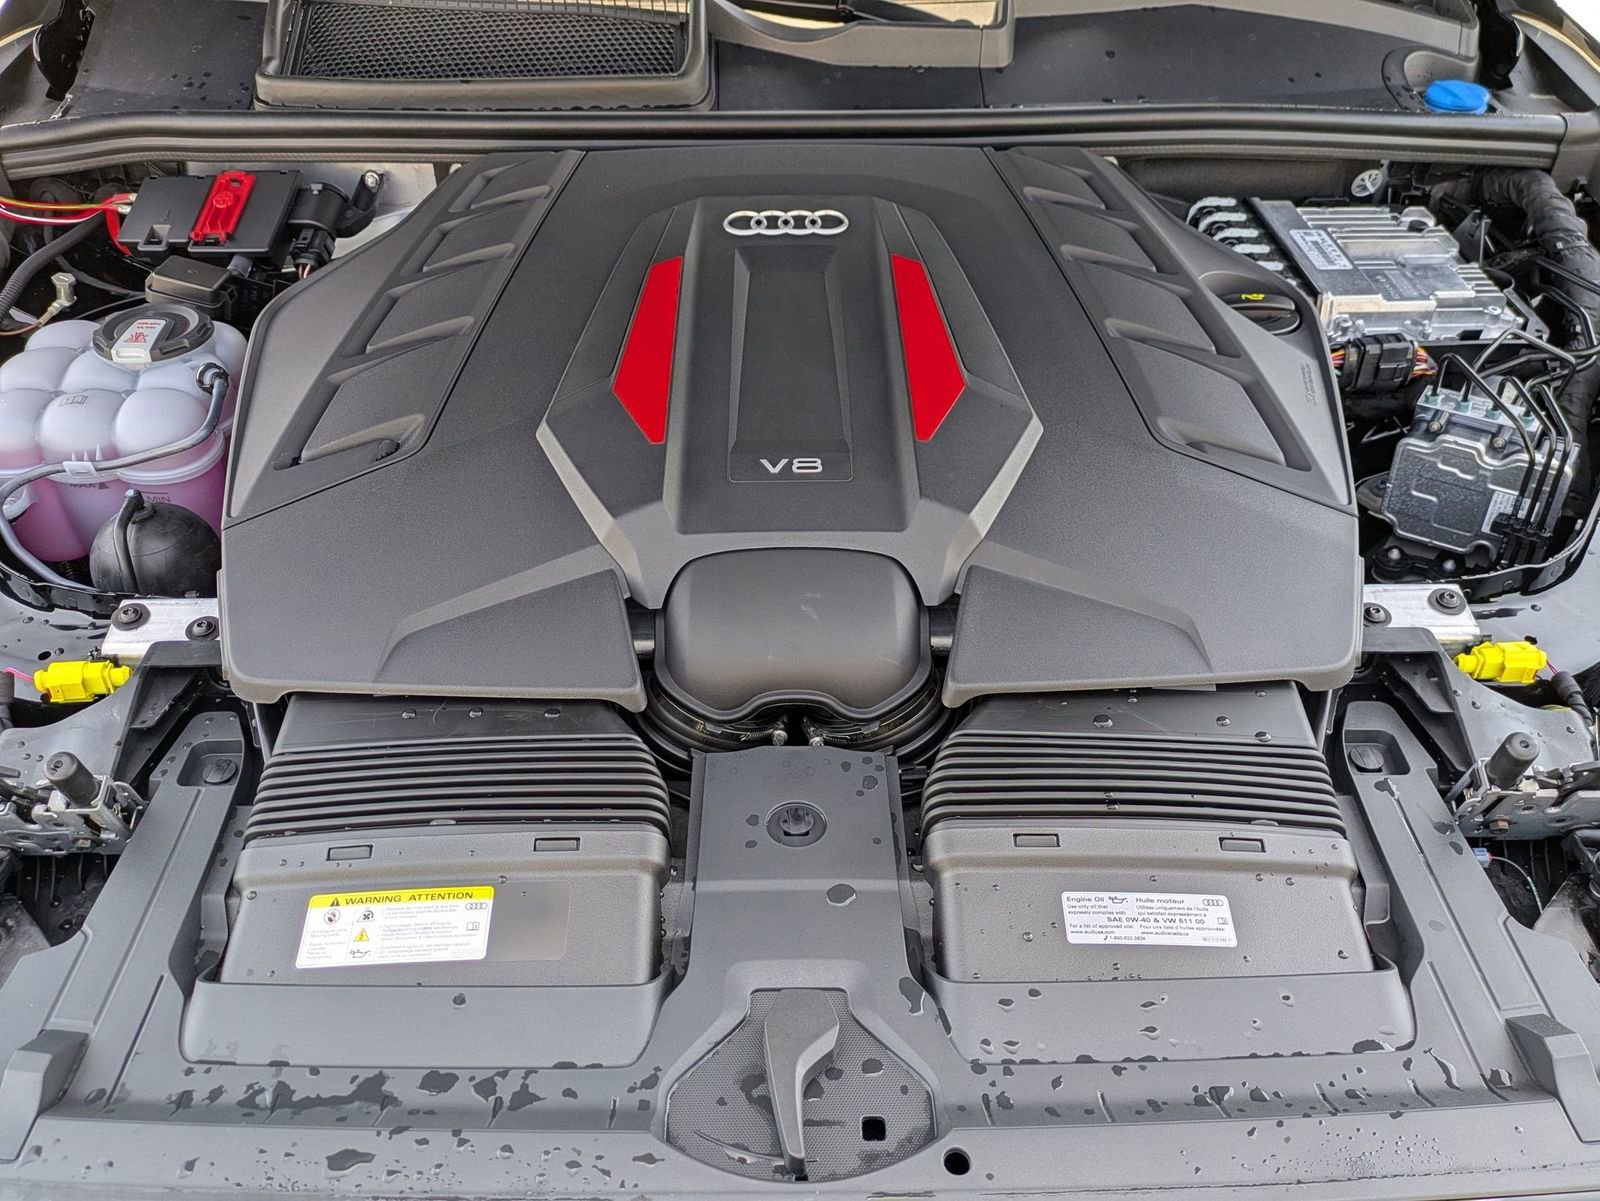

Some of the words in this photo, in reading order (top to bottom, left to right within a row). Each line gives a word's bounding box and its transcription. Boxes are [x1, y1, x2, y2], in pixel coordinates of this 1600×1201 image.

[760, 458, 822, 473] V8
[345, 895, 402, 905] WARNING
[408, 892, 474, 902] ATTENTION
